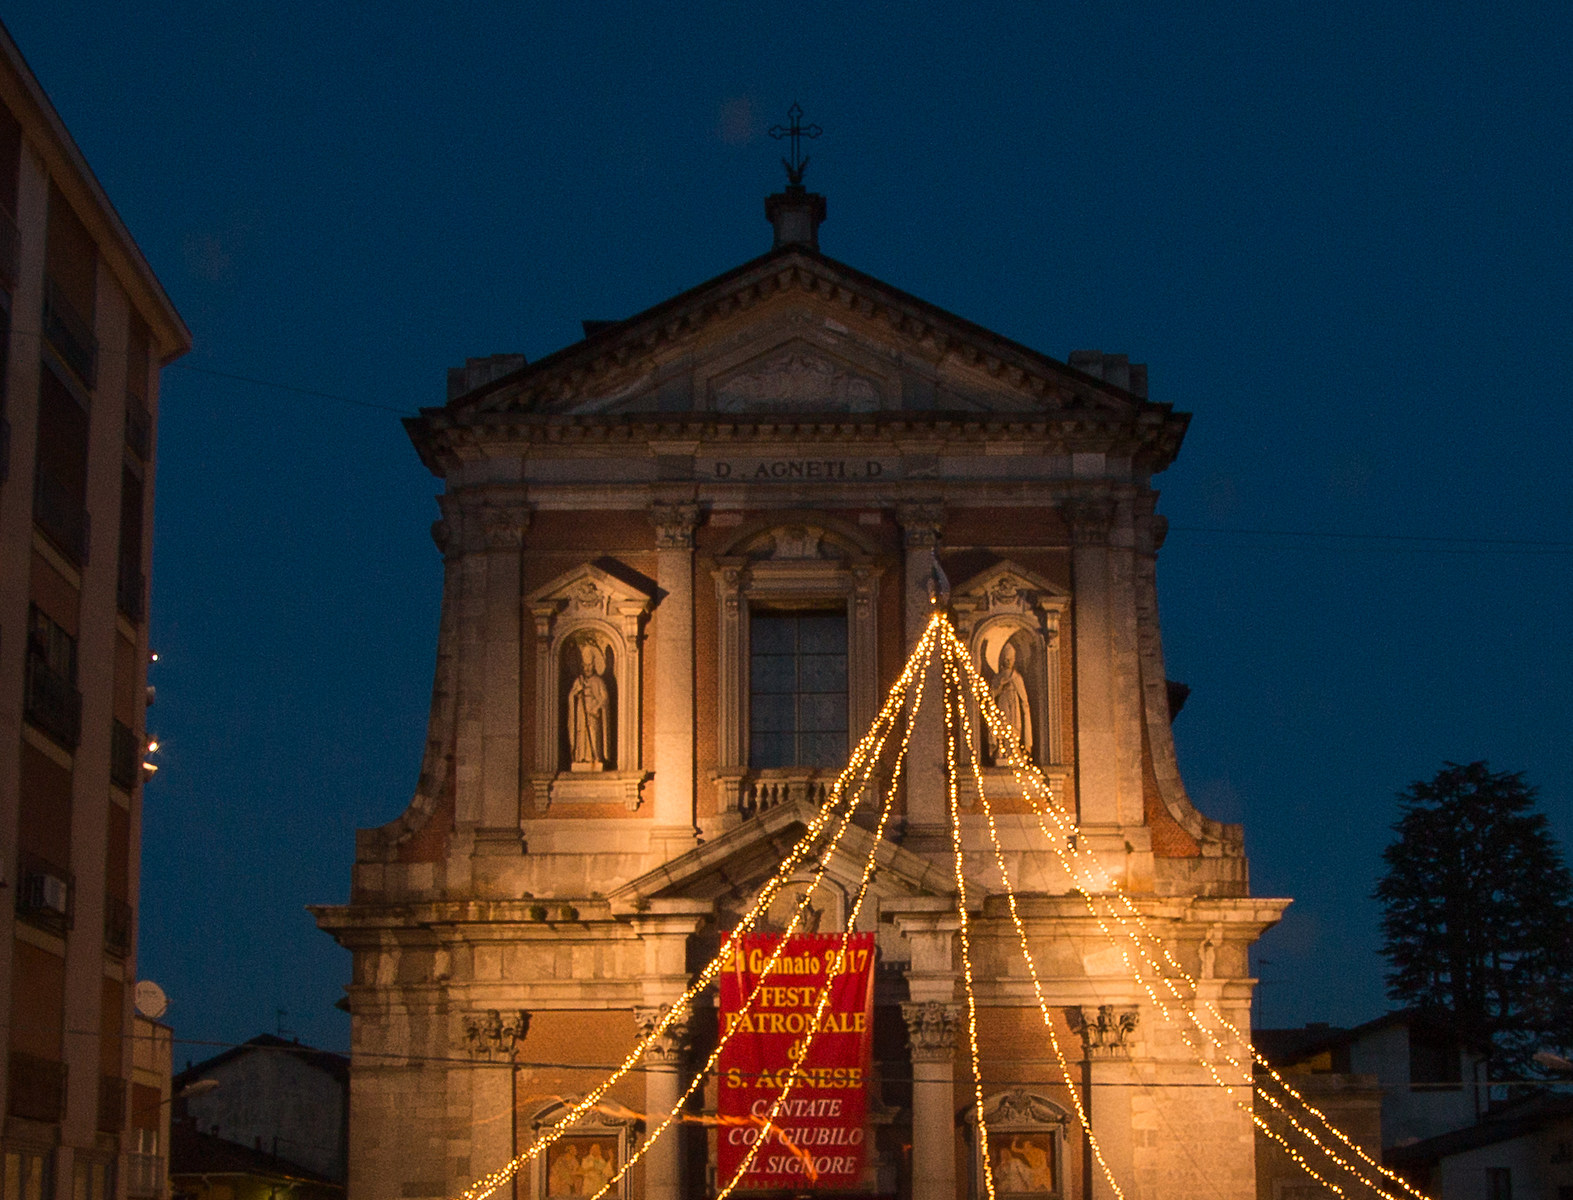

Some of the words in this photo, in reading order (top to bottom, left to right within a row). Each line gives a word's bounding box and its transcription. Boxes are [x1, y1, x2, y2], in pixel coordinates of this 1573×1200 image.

[749, 948, 820, 975] Gennaio
[824, 949, 868, 975] 2017
[760, 986, 832, 1008] FESTA
[724, 1012, 868, 1034] PATRONALE
[727, 1067, 749, 1089] S.
[755, 1068, 864, 1089] AGNESE
[751, 1099, 843, 1118] CANTATE
[728, 1127, 776, 1146] CON
[778, 1127, 865, 1146] GIUBILO
[765, 1156, 858, 1176] SIGNORE
